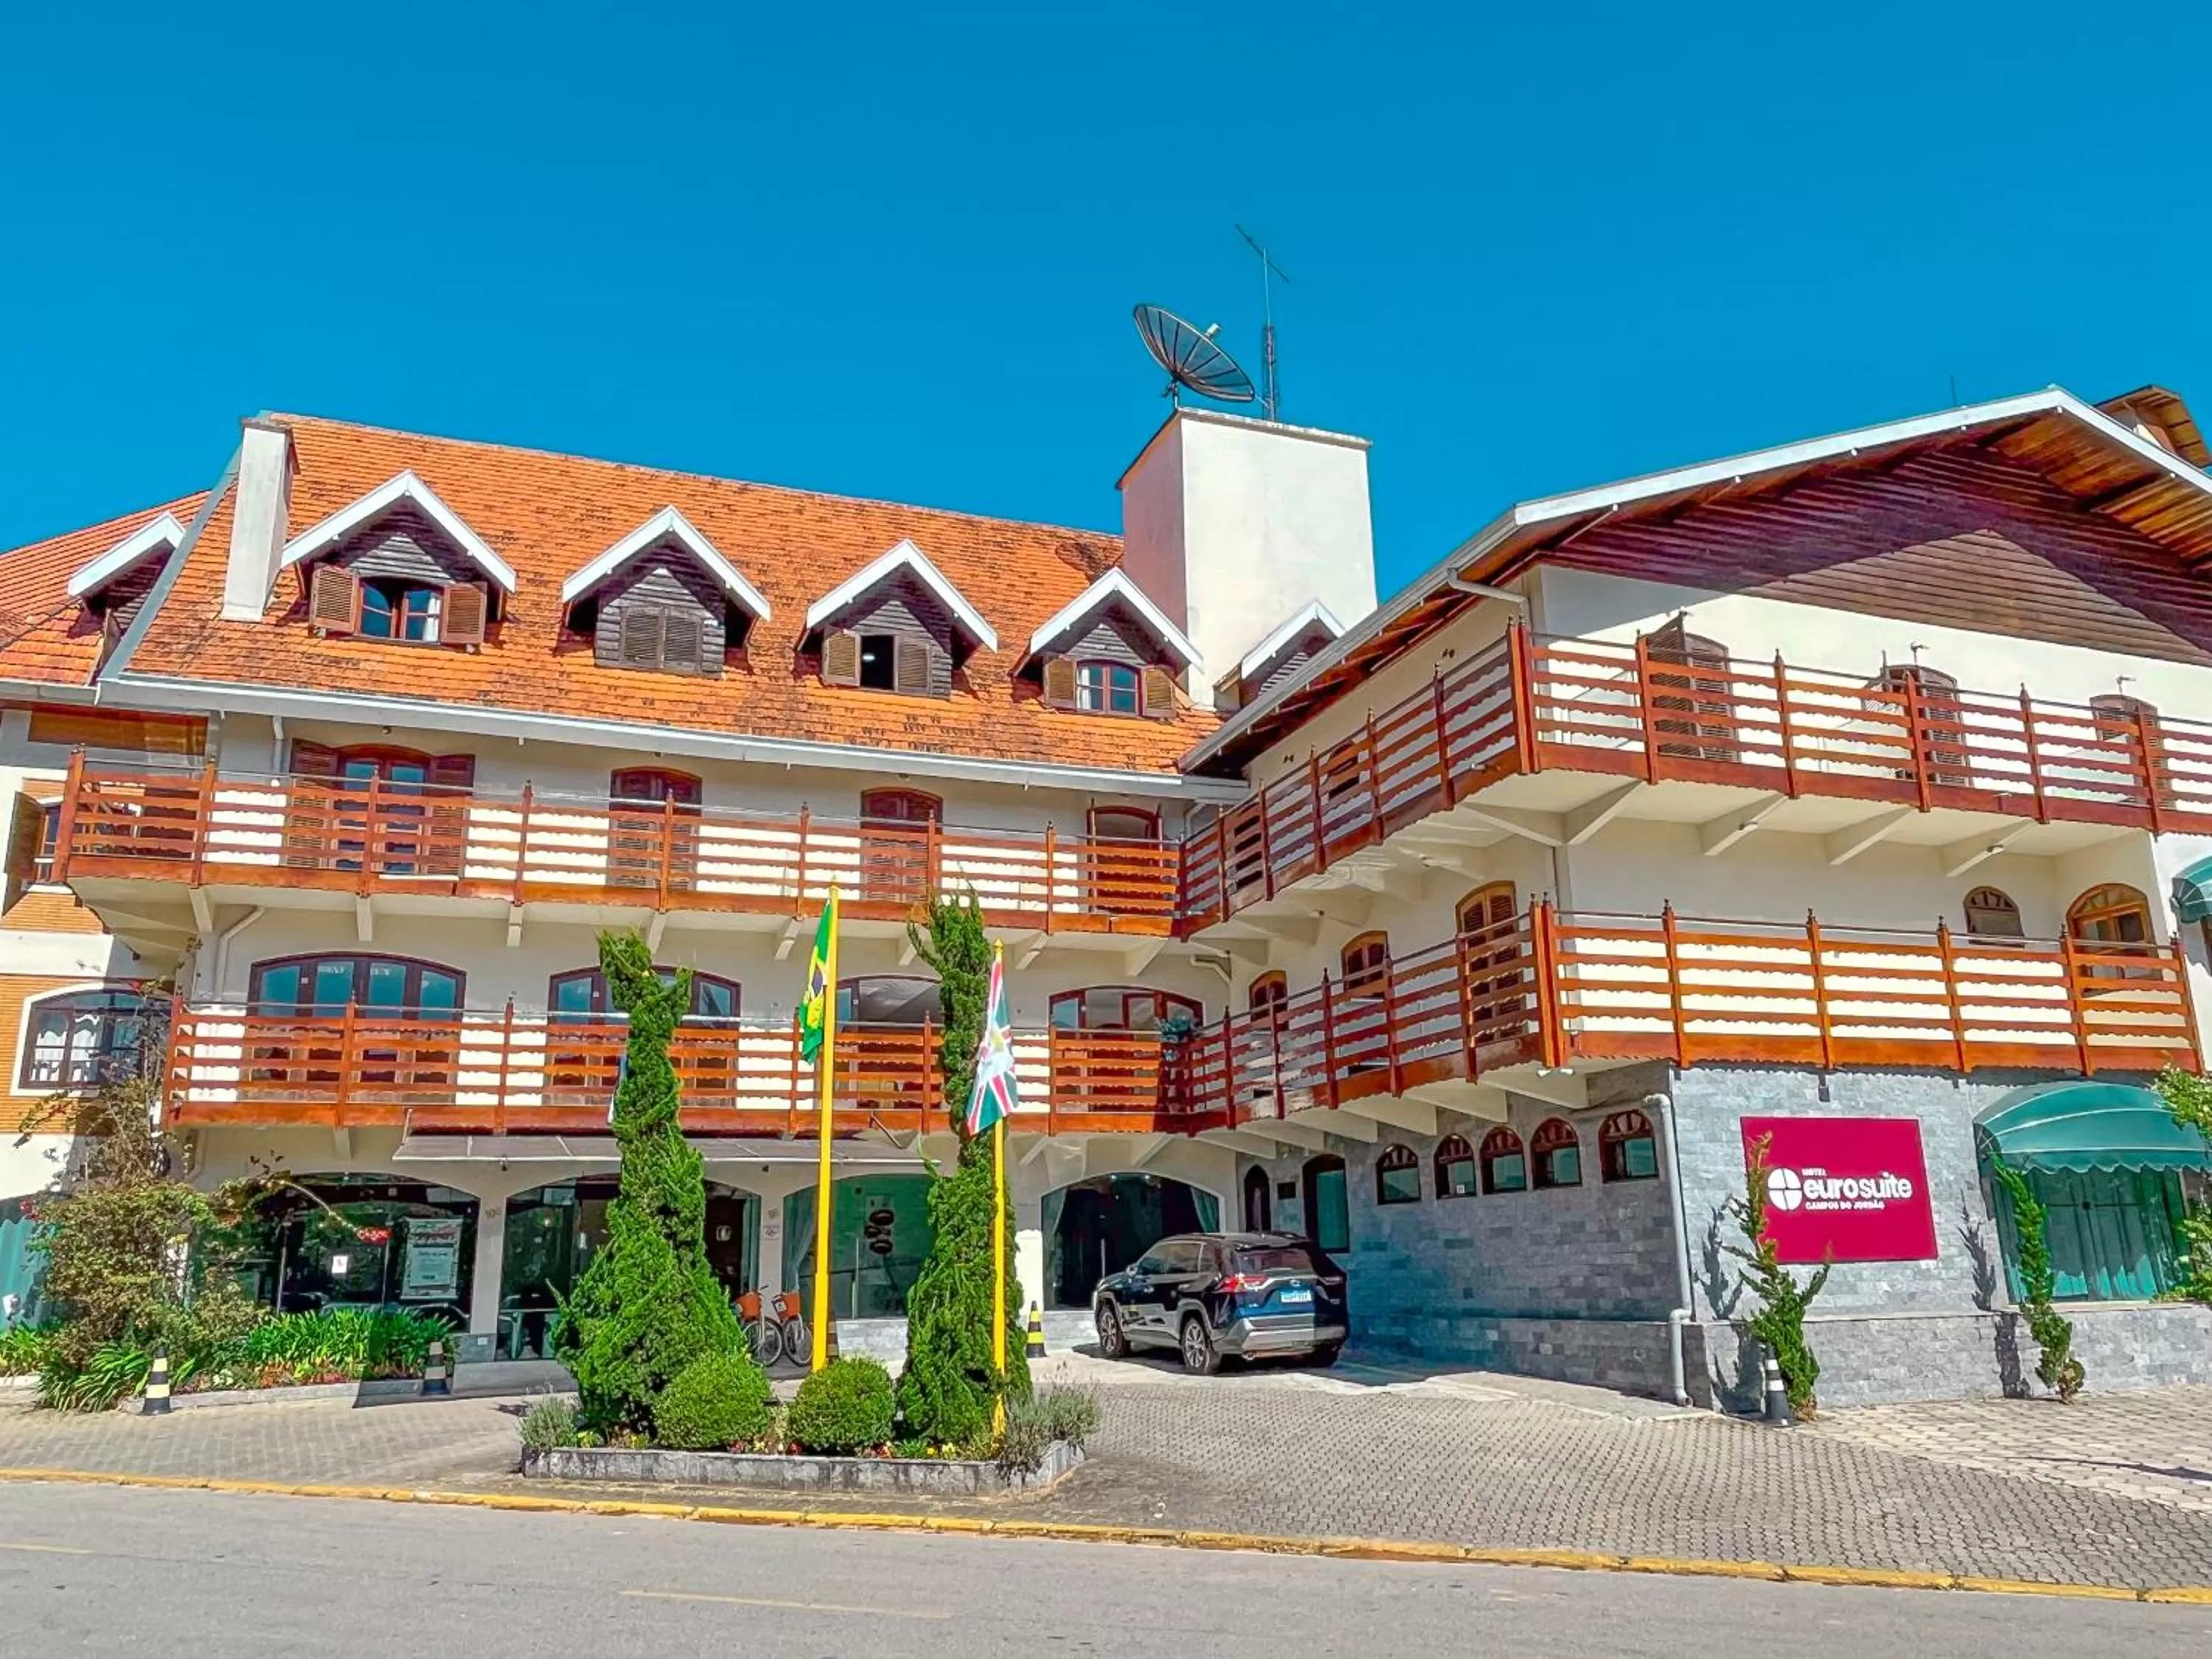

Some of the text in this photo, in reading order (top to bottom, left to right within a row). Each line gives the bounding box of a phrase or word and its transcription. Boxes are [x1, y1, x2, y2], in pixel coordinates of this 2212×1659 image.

[1804, 1172, 1913, 1199] eurosuite
[1806, 1201, 1839, 1210] CAMPOS
[1840, 1201, 1852, 1210] DO
